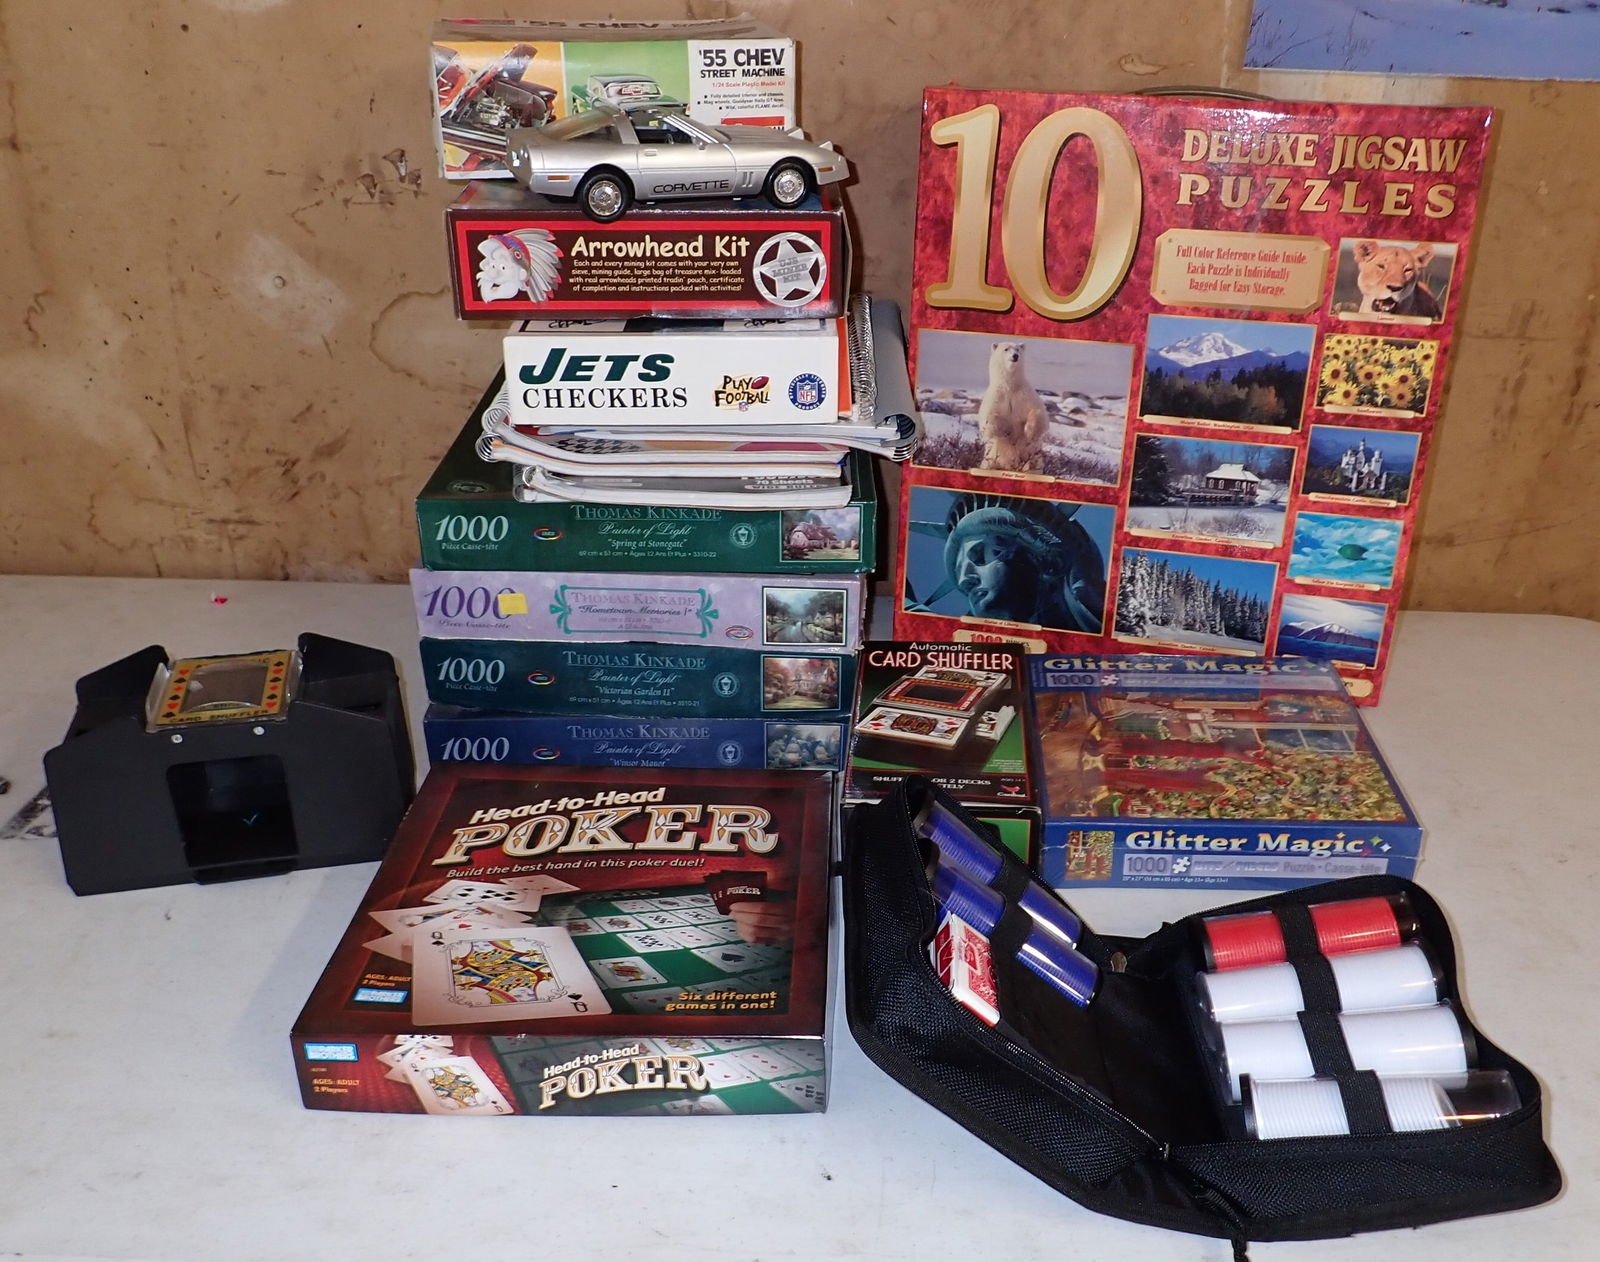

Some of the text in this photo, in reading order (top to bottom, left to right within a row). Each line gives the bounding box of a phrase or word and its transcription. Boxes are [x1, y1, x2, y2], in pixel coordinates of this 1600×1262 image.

[699, 48, 785, 67] '55 CHEV
[700, 68, 785, 78] STREET MACHINE
[1179, 127, 1469, 176] DELUXE JIGSAW
[653, 180, 729, 194] CORVETTE
[1174, 172, 1459, 220] PUZZLES
[923, 102, 1144, 321] 10
[570, 234, 750, 258] Arrowhead Kit
[1176, 245, 1308, 265] Full Color Reference Guide Inside.
[591, 268, 612, 276] mining
[614, 268, 632, 276] guide,
[634, 268, 651, 276] large
[652, 268, 665, 276] bag
[624, 260, 645, 268] mining
[1187, 262, 1291, 282] Each Puzzle is Individually
[582, 285, 616, 293] completion
[1189, 278, 1286, 297] Bagged for Easy Storage.
[518, 347, 675, 385] JETS
[722, 375, 753, 391] PLAY
[522, 386, 688, 410] CHECKERS
[714, 390, 771, 407] FOOTBALL
[800, 390, 816, 401] NFL
[570, 504, 722, 520] THOMAS KINKADE
[435, 515, 509, 541] 1000
[598, 521, 642, 535] Painter
[642, 525, 656, 538] of
[608, 538, 637, 548] "Spring
[649, 539, 688, 550] Stonegate"
[571, 592, 695, 607] THOMAS KINKADE
[909, 642, 972, 651] Automatic
[562, 650, 707, 669] THOMAS KINKADE
[869, 650, 1013, 670] CARD SHUFFLER
[1044, 656, 1302, 676] Glitter Magic
[437, 656, 505, 685] 1000
[588, 668, 628, 682] Painter
[630, 671, 643, 686] of
[1050, 674, 1094, 685] 1000
[634, 687, 662, 696] Garden
[209, 710, 268, 719] SHUFFLER
[567, 725, 711, 738] THOMAS KINKADE
[441, 737, 510, 761] 1000
[593, 741, 633, 754] Painter
[634, 744, 647, 758] of
[468, 786, 667, 825] Head-to-Head
[431, 802, 779, 867] POKER
[1125, 829, 1365, 859] Glitter Magic
[446, 857, 705, 878] Build the best hand in this poker duel!
[1127, 857, 1168, 873] 1000
[1282, 861, 1316, 873] Puzzle
[727, 886, 761, 895] POKER
[678, 991, 778, 1000] Six different
[665, 1000, 775, 1012] games in one!
[543, 1044, 640, 1080] Head-to-Head
[538, 1054, 709, 1110] POKER
